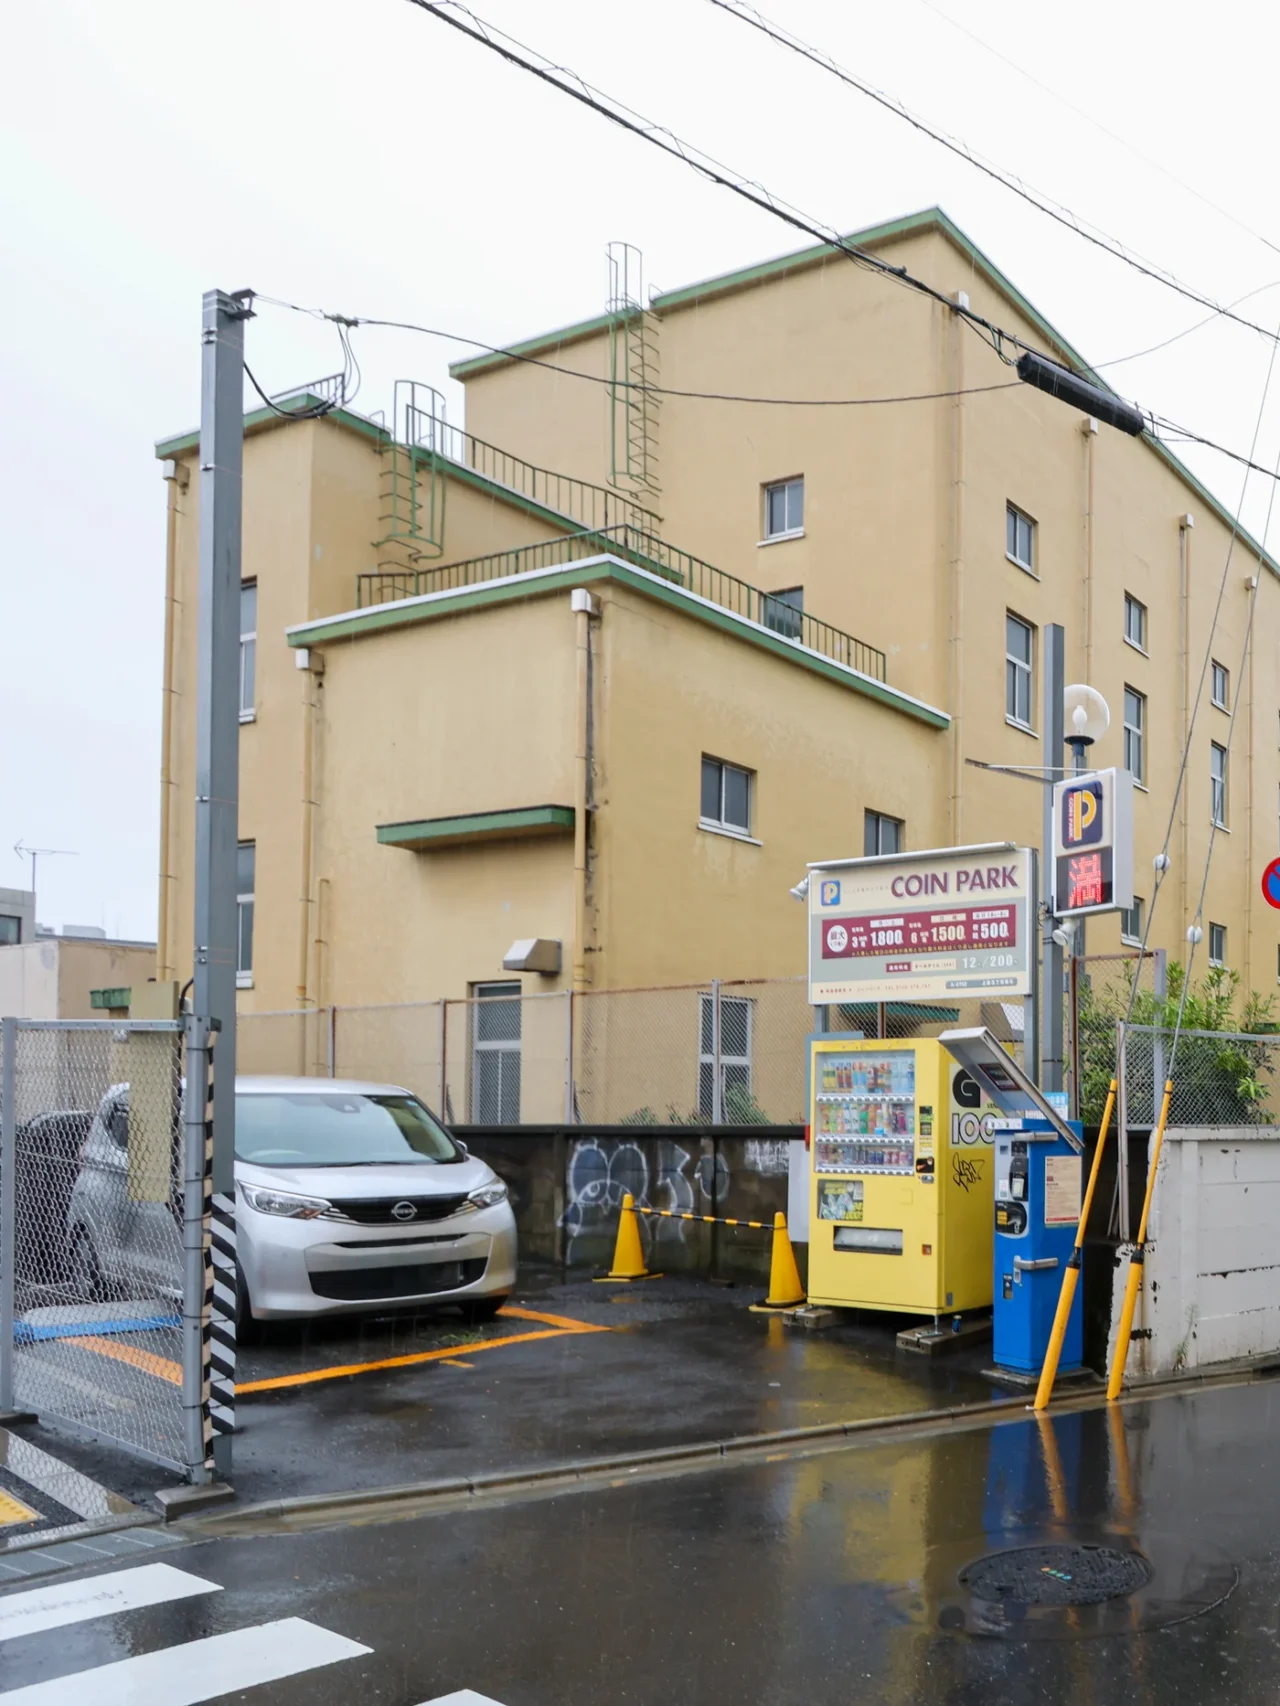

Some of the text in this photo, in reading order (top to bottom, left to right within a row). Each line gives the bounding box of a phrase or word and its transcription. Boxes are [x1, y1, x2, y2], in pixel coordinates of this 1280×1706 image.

[891, 865, 1018, 897] COIN PARK
[1069, 854, 1103, 908] 満
